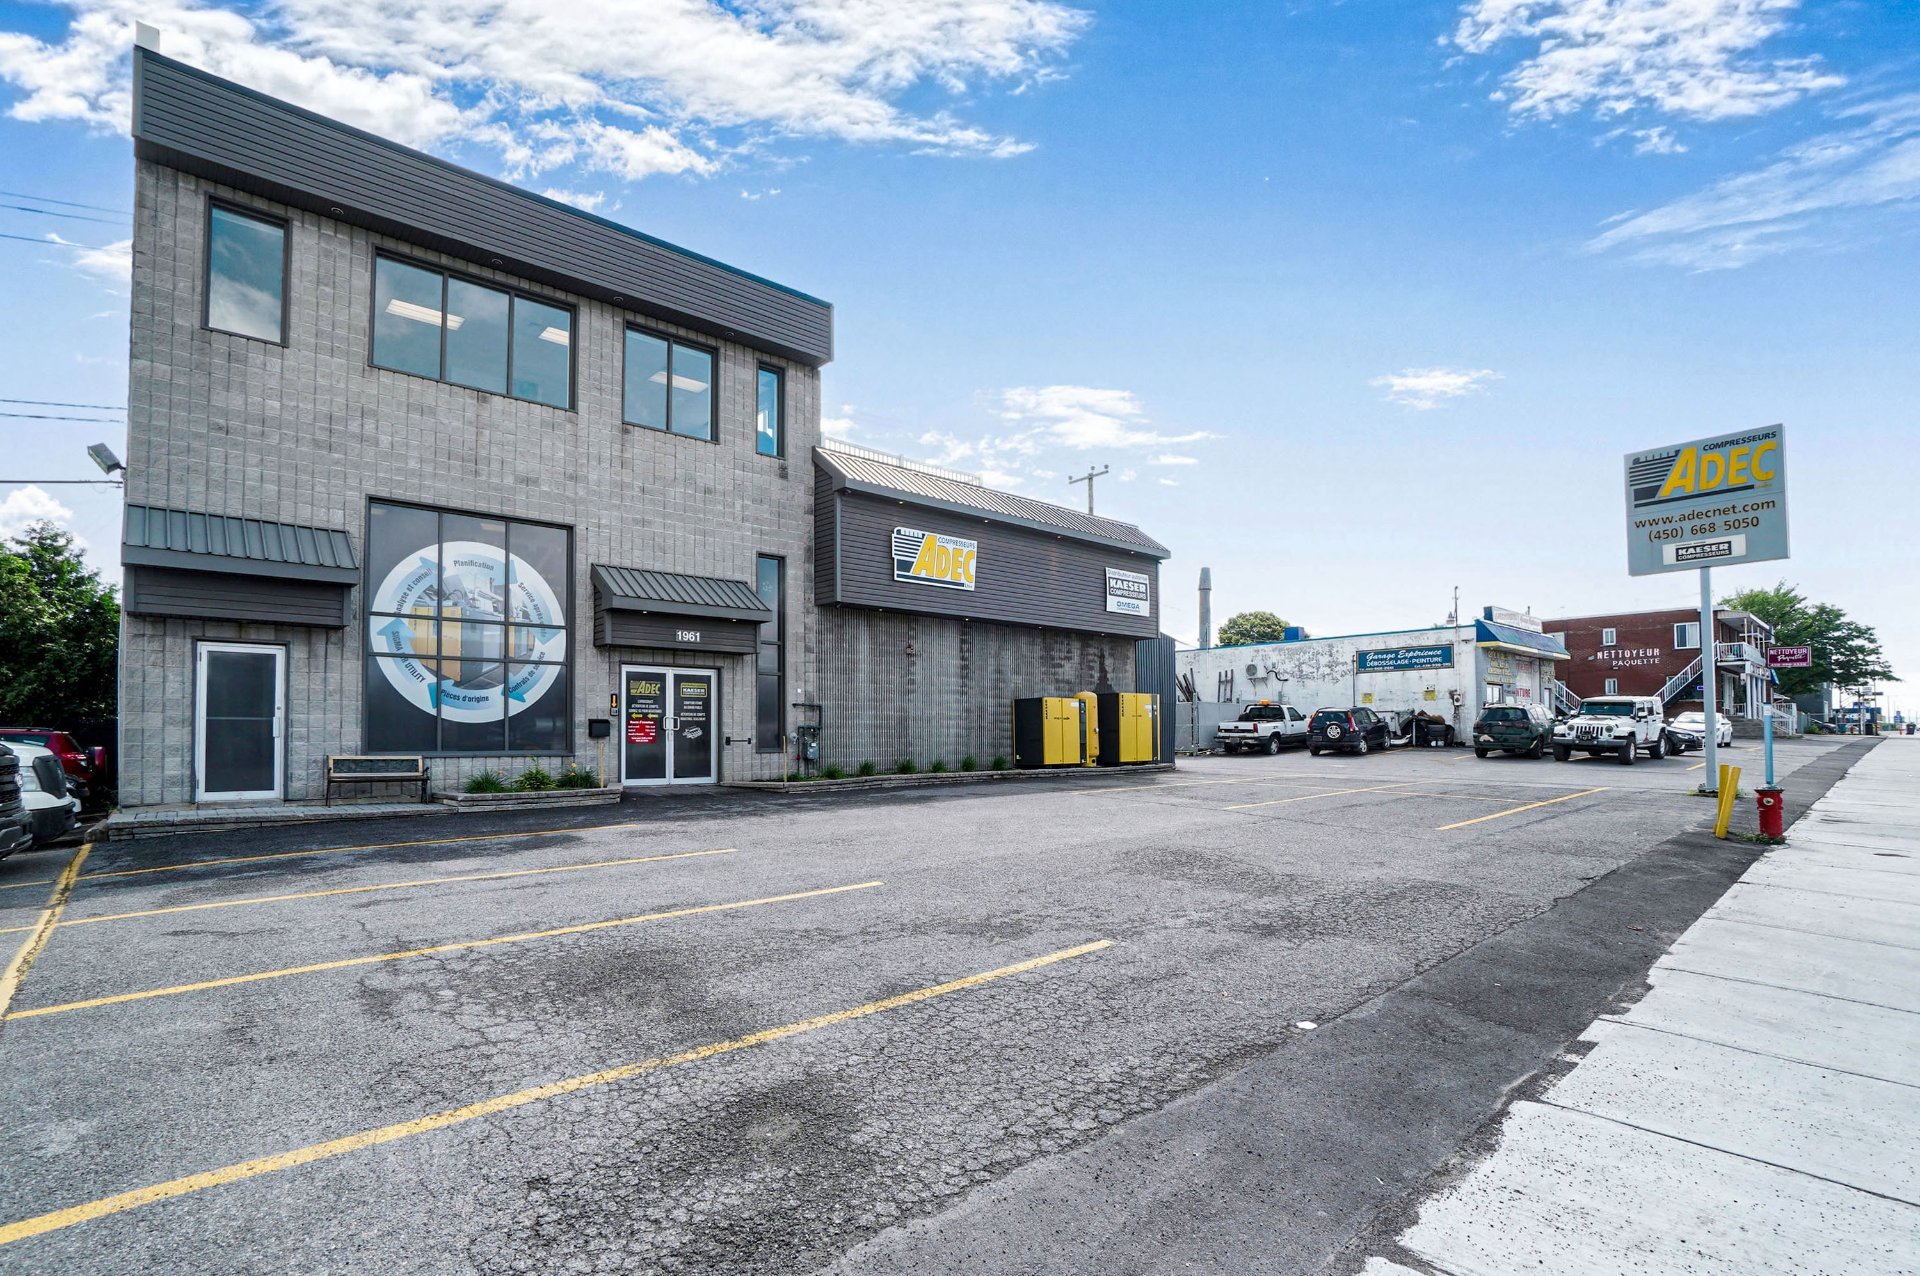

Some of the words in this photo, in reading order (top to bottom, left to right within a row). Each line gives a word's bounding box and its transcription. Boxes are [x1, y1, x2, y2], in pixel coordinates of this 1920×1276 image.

[1702, 431, 1777, 451] COMPRESSEURS
[1659, 441, 1777, 497] ADEC
[1634, 499, 1776, 529] www.adecnet.com
[1648, 526, 1684, 543] (450)
[1690, 522, 1717, 536] 668
[1723, 516, 1760, 531] 5050
[937, 537, 976, 549] COMPRESSEURS
[1678, 543, 1729, 555] KAESER
[912, 534, 976, 584] ADEC
[1678, 549, 1730, 561] COMPRESSEURS
[453, 559, 495, 571] Planification
[1110, 579, 1146, 593] KAESER
[518, 582, 536, 603] Service
[1116, 600, 1141, 610] OMEGA
[676, 630, 700, 642] 1961
[1366, 652, 1396, 661] Garage
[1411, 656, 1443, 664] PEINTURE
[1597, 648, 1660, 660] NETTOYEUR
[1612, 658, 1661, 667] PAQUETTE
[405, 662, 426, 683] UTILITY
[508, 675, 531, 694] Contrats
[637, 681, 660, 694] ADEC
[462, 695, 490, 704] d'origine
